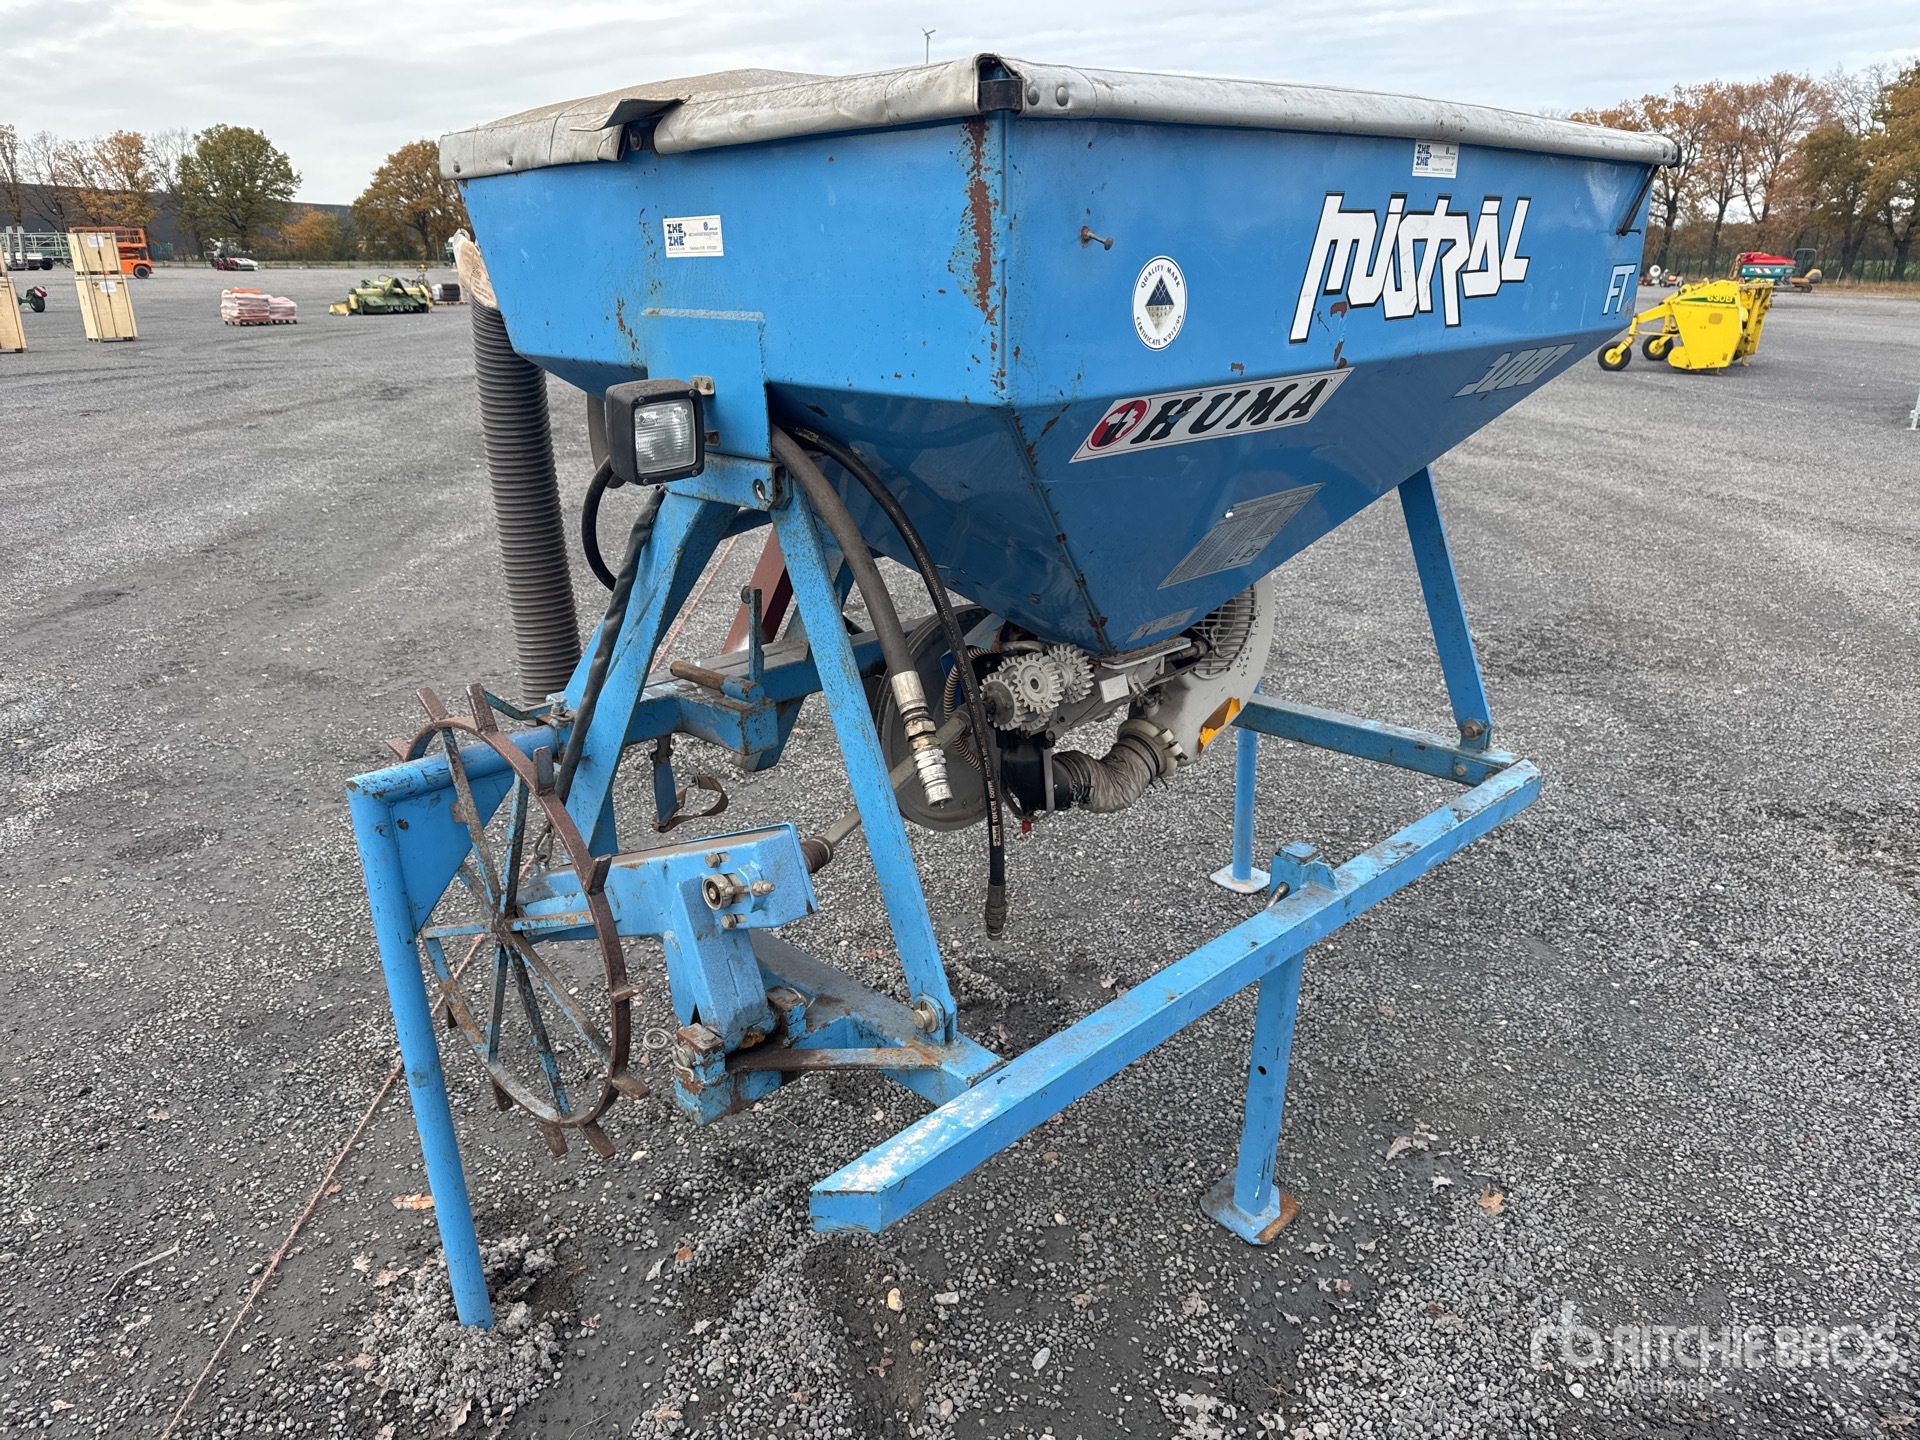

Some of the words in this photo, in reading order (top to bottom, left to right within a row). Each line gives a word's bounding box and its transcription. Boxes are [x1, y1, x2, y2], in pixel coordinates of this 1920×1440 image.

[1140, 264, 1164, 289] QUALITY
[1166, 266, 1181, 288] MARK
[1602, 263, 1637, 315] FT
[1136, 316, 1161, 345] CERTIFICATE
